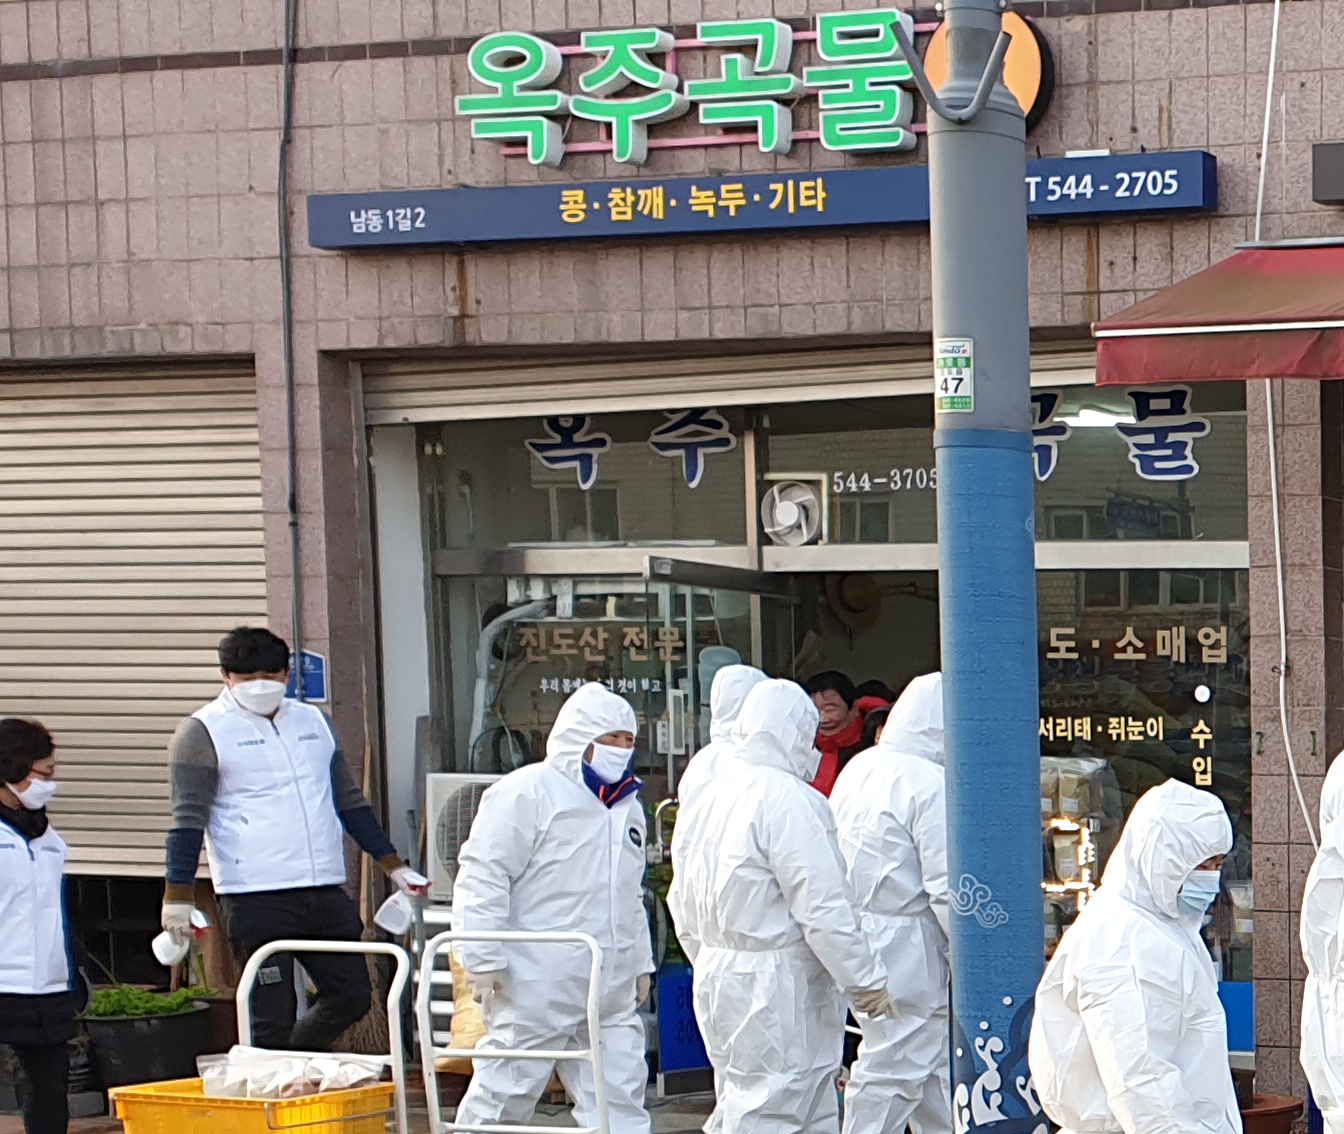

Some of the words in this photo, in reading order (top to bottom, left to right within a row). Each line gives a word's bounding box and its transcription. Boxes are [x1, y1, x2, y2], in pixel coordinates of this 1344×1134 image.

[457, 8, 918, 167] 옥주곡물
[940, 377, 965, 395] 47
[833, 468, 938, 493] 544-3705
[519, 626, 609, 662] 진도산
